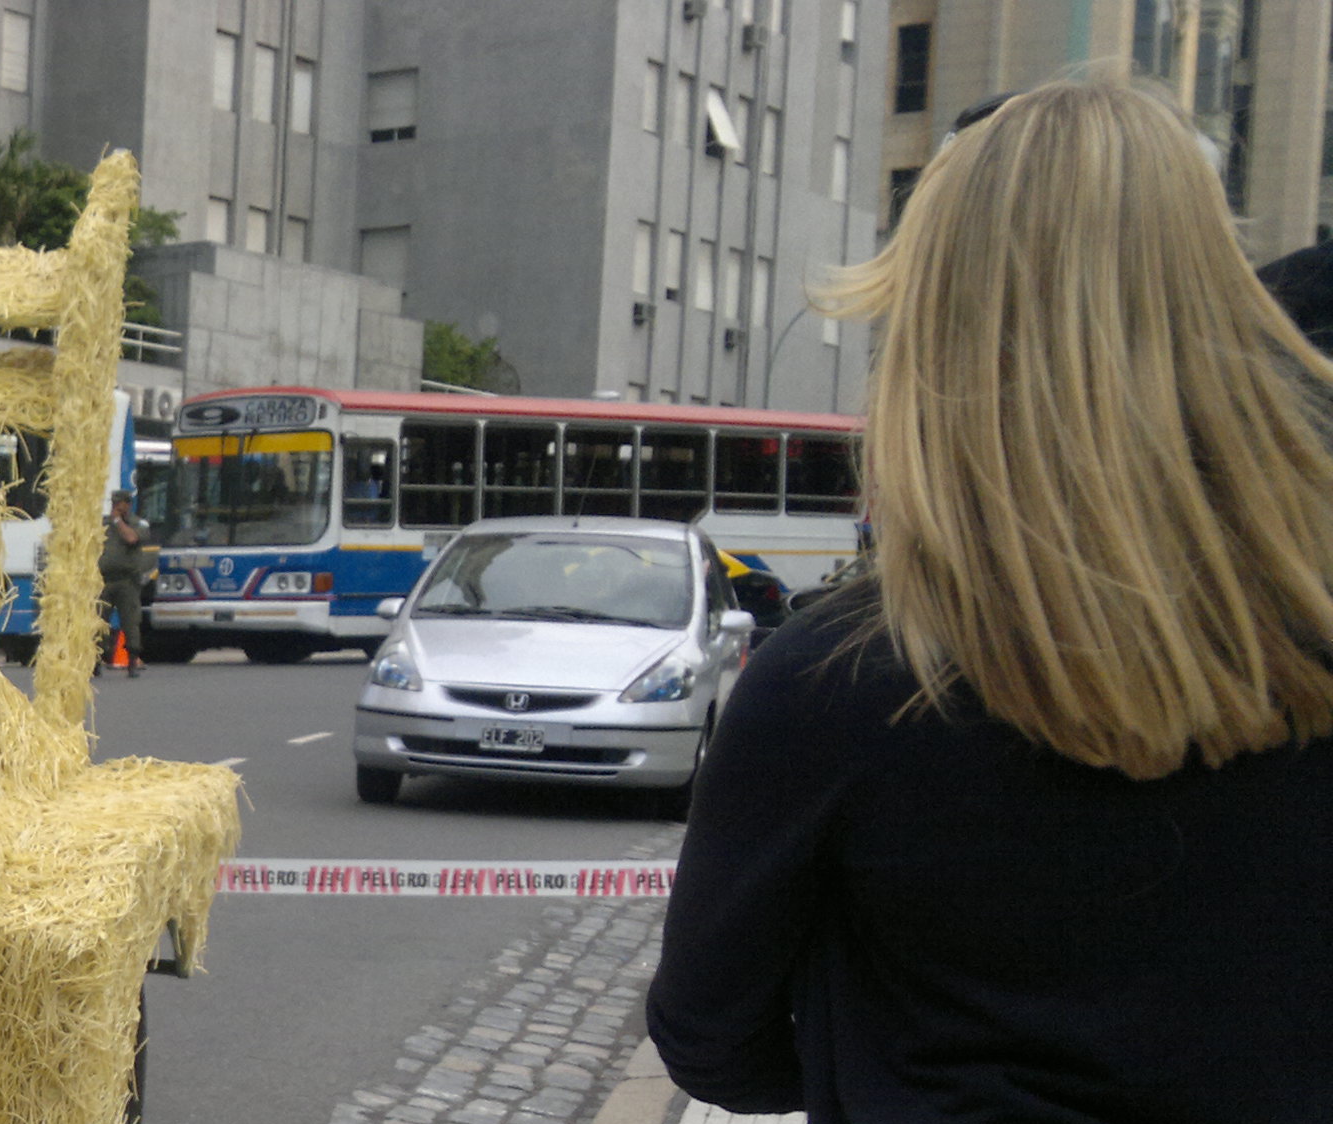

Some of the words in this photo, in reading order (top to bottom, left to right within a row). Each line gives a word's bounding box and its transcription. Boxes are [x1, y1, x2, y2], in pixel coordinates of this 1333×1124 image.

[244, 410, 308, 425] RETIRO
[516, 730, 543, 746] 202
[234, 868, 296, 888] PELIGRO
[362, 870, 428, 888] PELIGRO
[496, 873, 565, 890] PELIGRO
[636, 874, 674, 890] PELI
